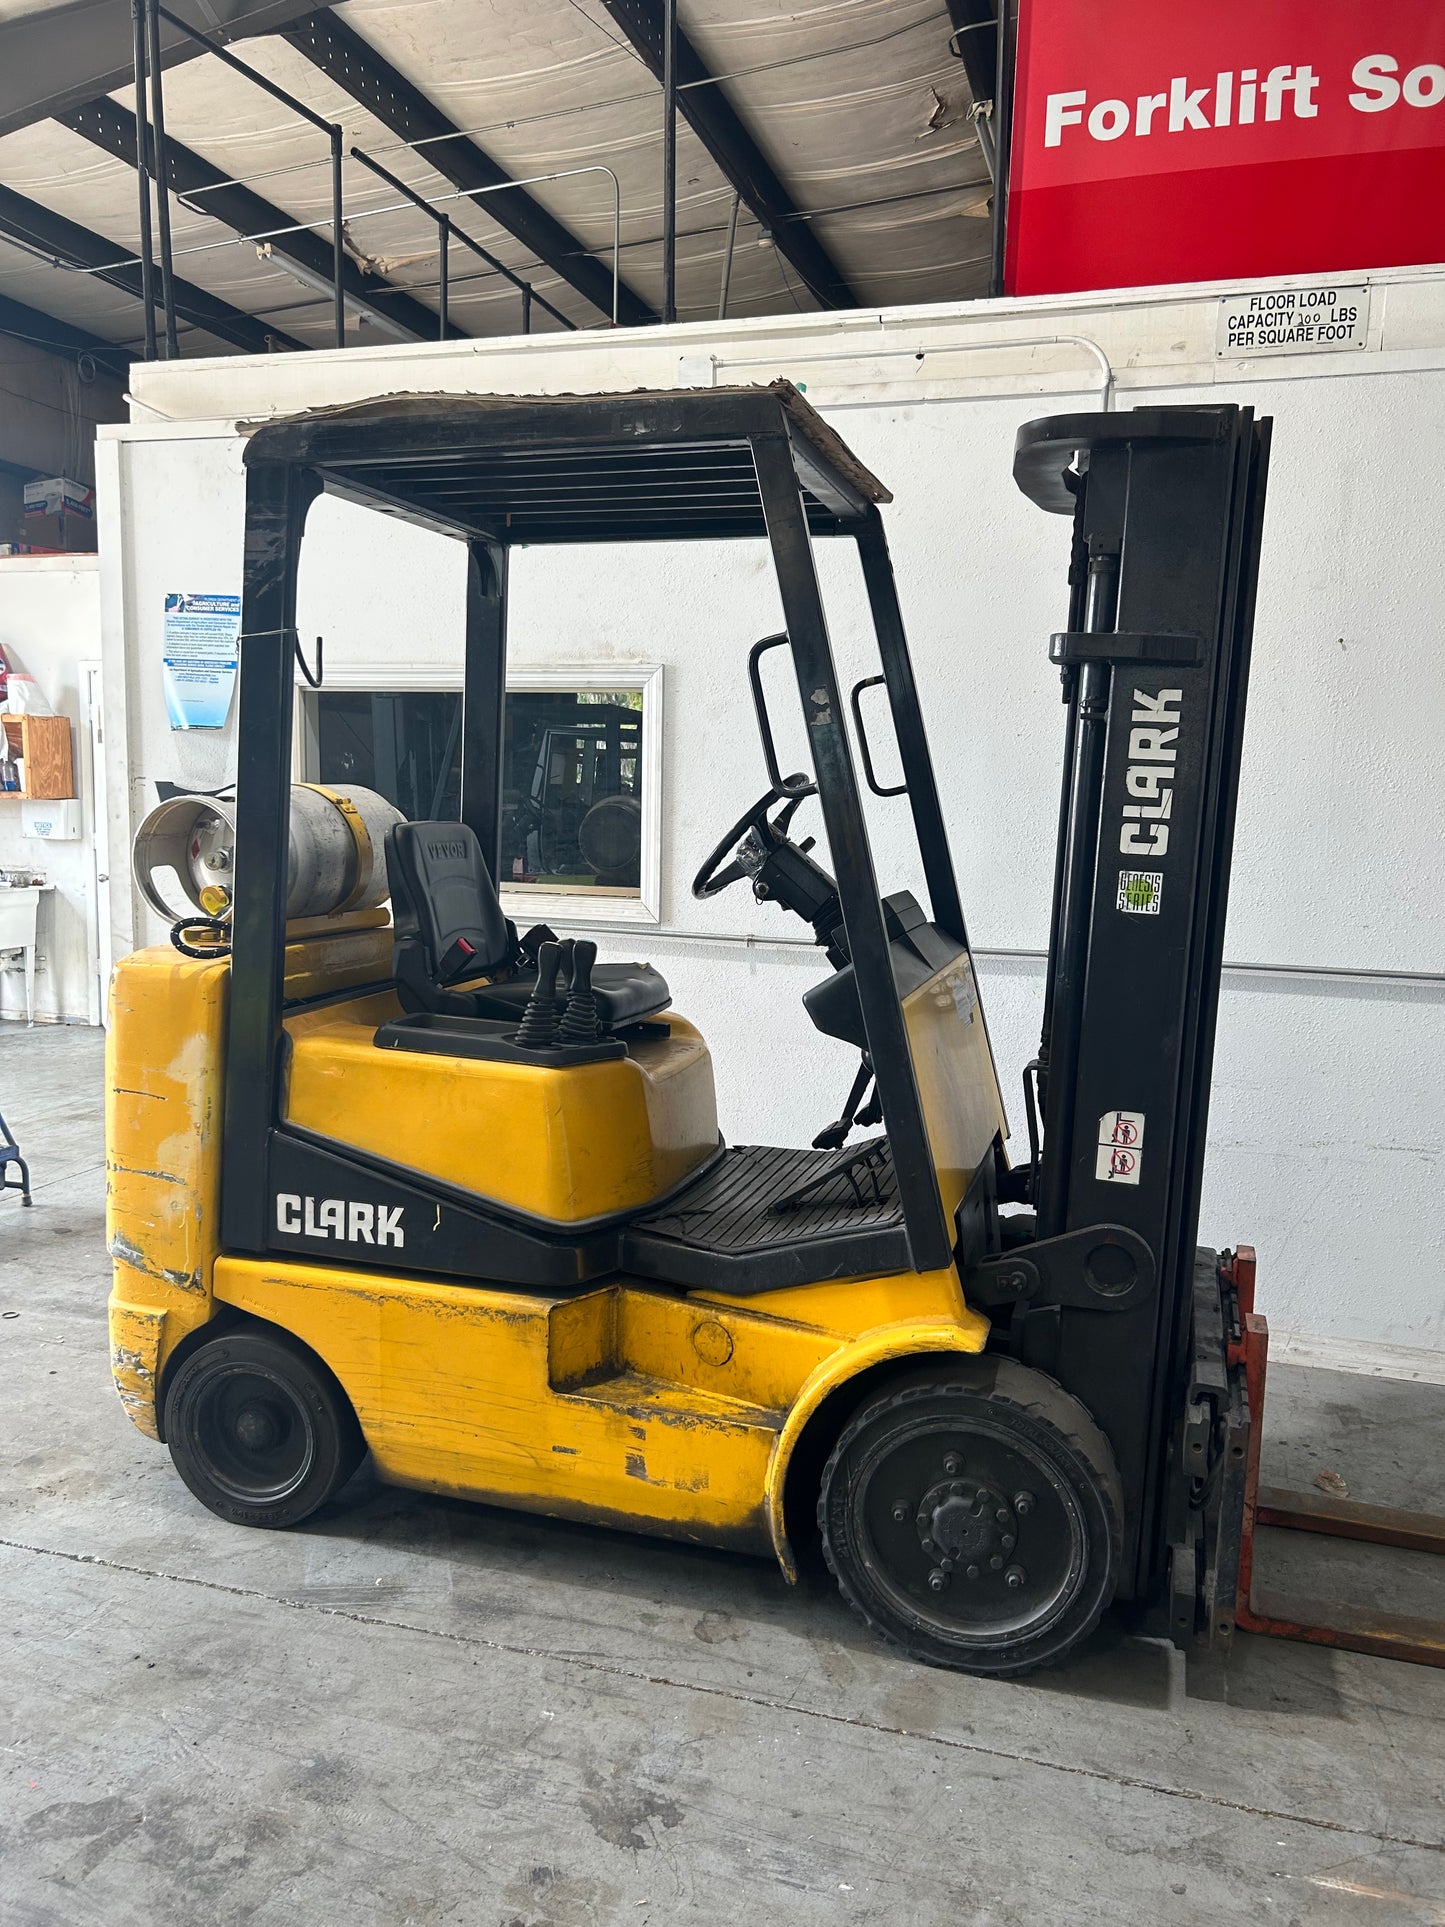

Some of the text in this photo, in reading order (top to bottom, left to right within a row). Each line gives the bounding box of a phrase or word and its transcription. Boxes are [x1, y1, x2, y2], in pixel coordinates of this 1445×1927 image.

[1044, 53, 1445, 148] Forklift So
[1250, 291, 1337, 311] FLOOR LOAD
[1228, 311, 1295, 330] CAPACITY
[1330, 307, 1357, 323] LBS
[1228, 324, 1355, 347] PER SQUARE FOOT
[1119, 688, 1183, 856] CLARK
[1120, 873, 1161, 893] GENESIS
[1118, 892, 1159, 913] SERIES
[276, 1193, 405, 1248] CLARK
